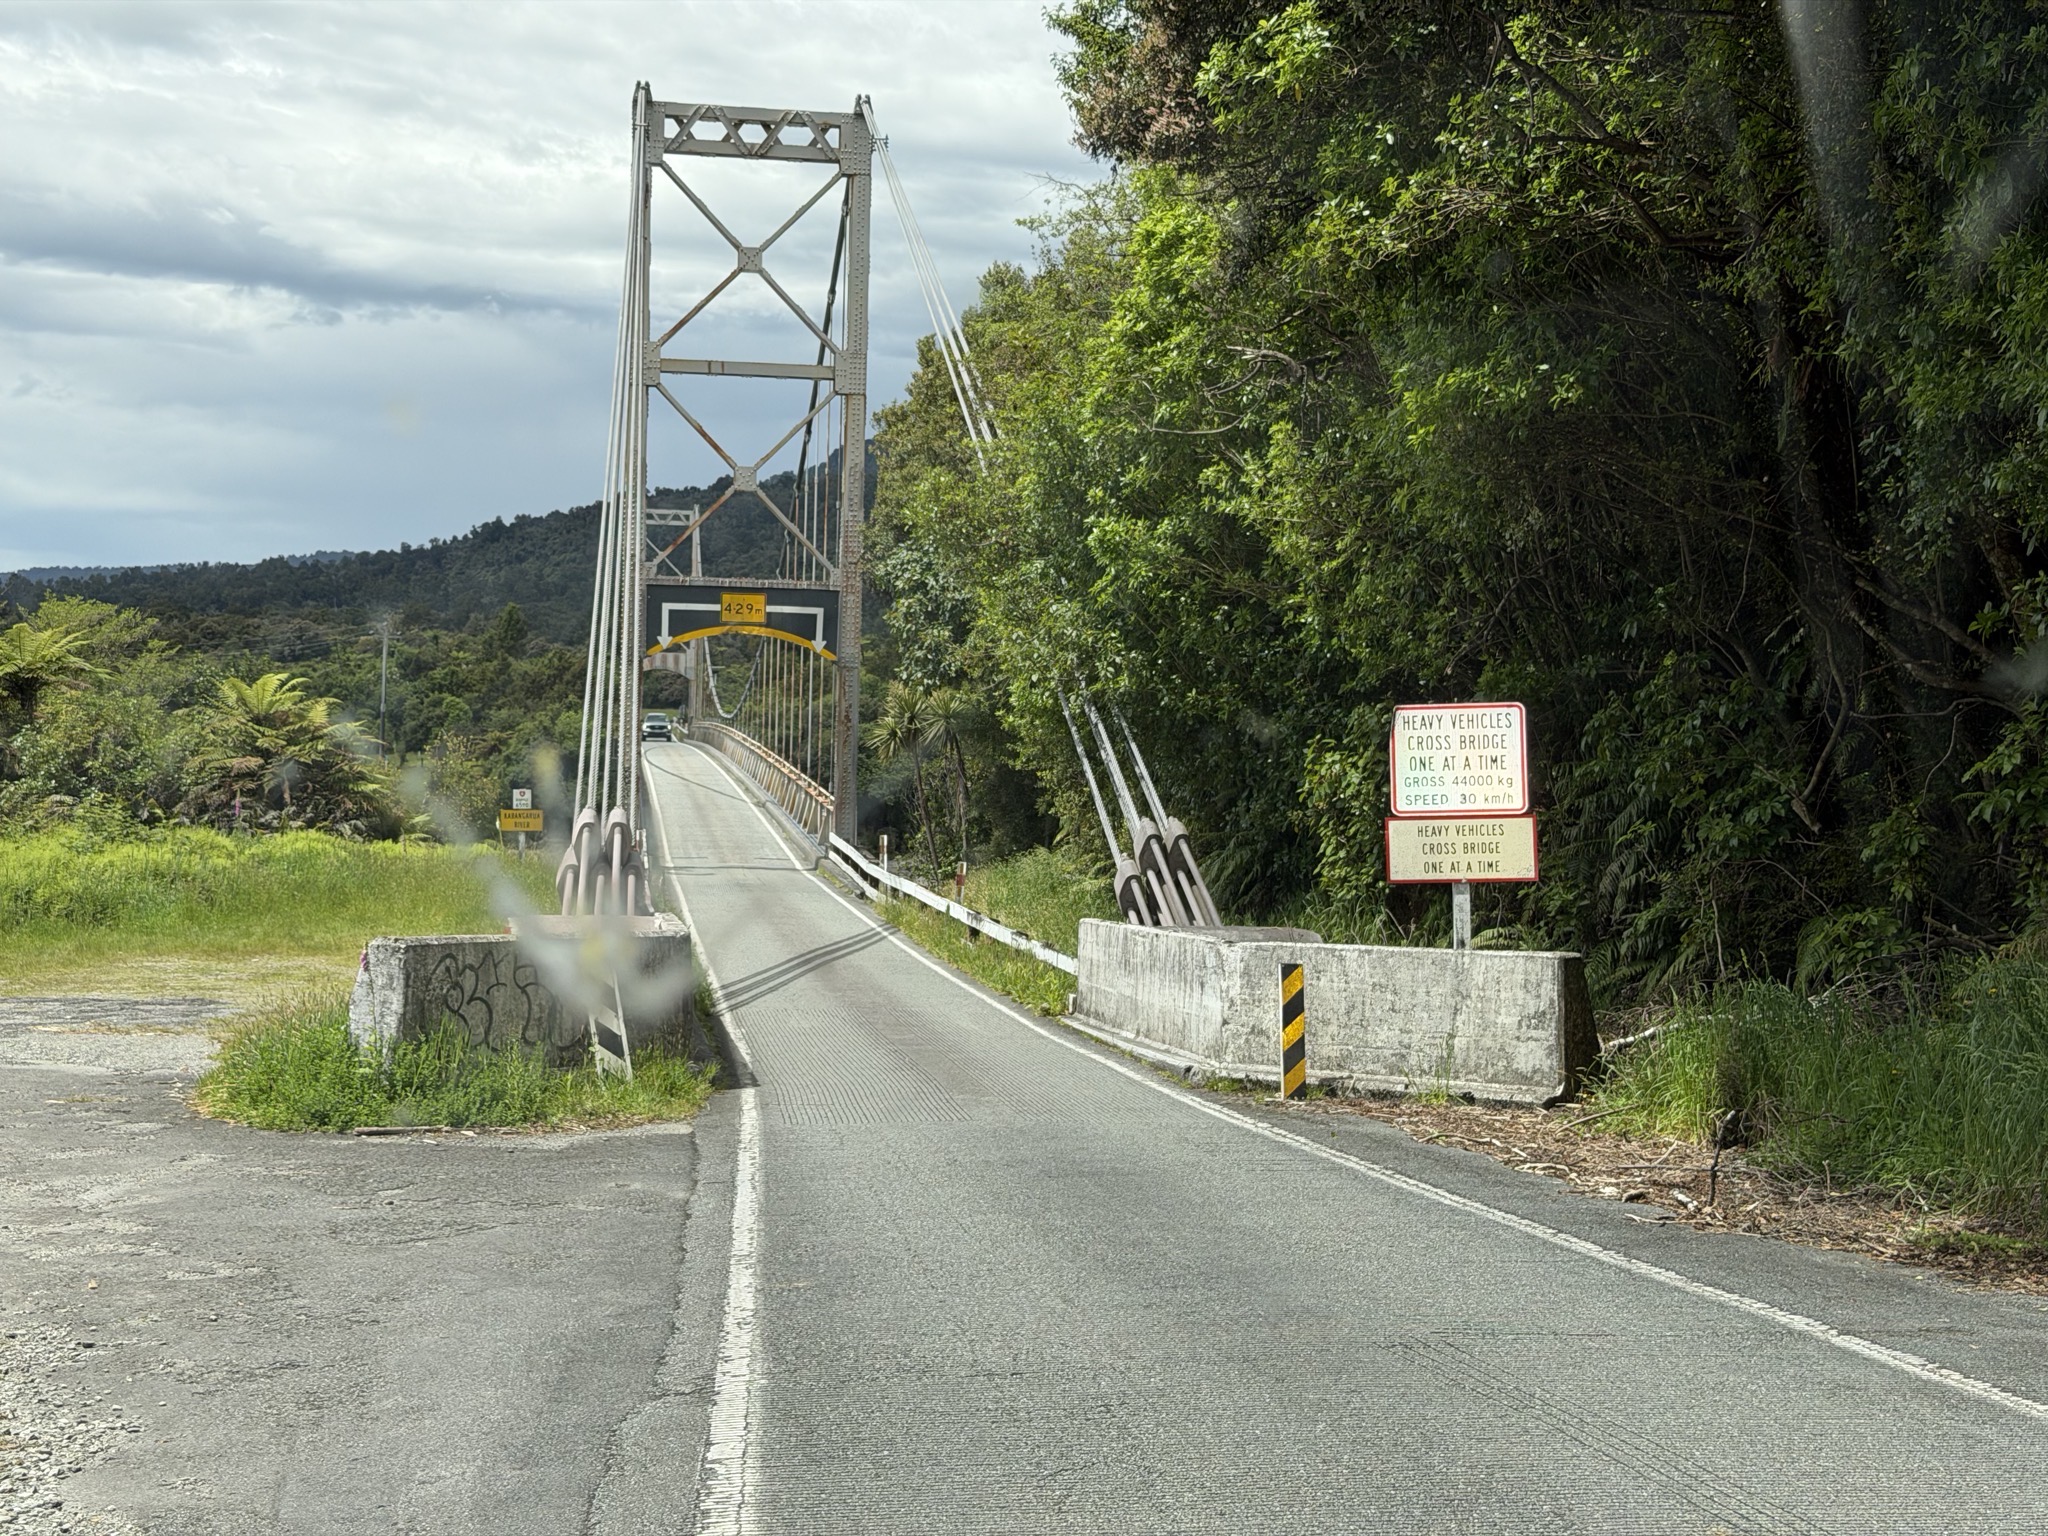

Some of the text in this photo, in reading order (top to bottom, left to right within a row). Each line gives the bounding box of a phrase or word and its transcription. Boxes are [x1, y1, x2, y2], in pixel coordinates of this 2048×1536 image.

[1402, 712, 1513, 731] HEAVY VEHICLES
[1407, 733, 1508, 751] CROSS BRIDGE
[1409, 754, 1507, 772] ONE AT A TIME
[1404, 775, 1513, 788] GROSS 44000 kg
[1405, 792, 1514, 806] SPEED 30 km/h
[1417, 824, 1505, 838] HEAVY VEHICLES
[1422, 841, 1501, 855] CROSS BRIDGE
[1423, 860, 1501, 874] ONE AT A TIME
